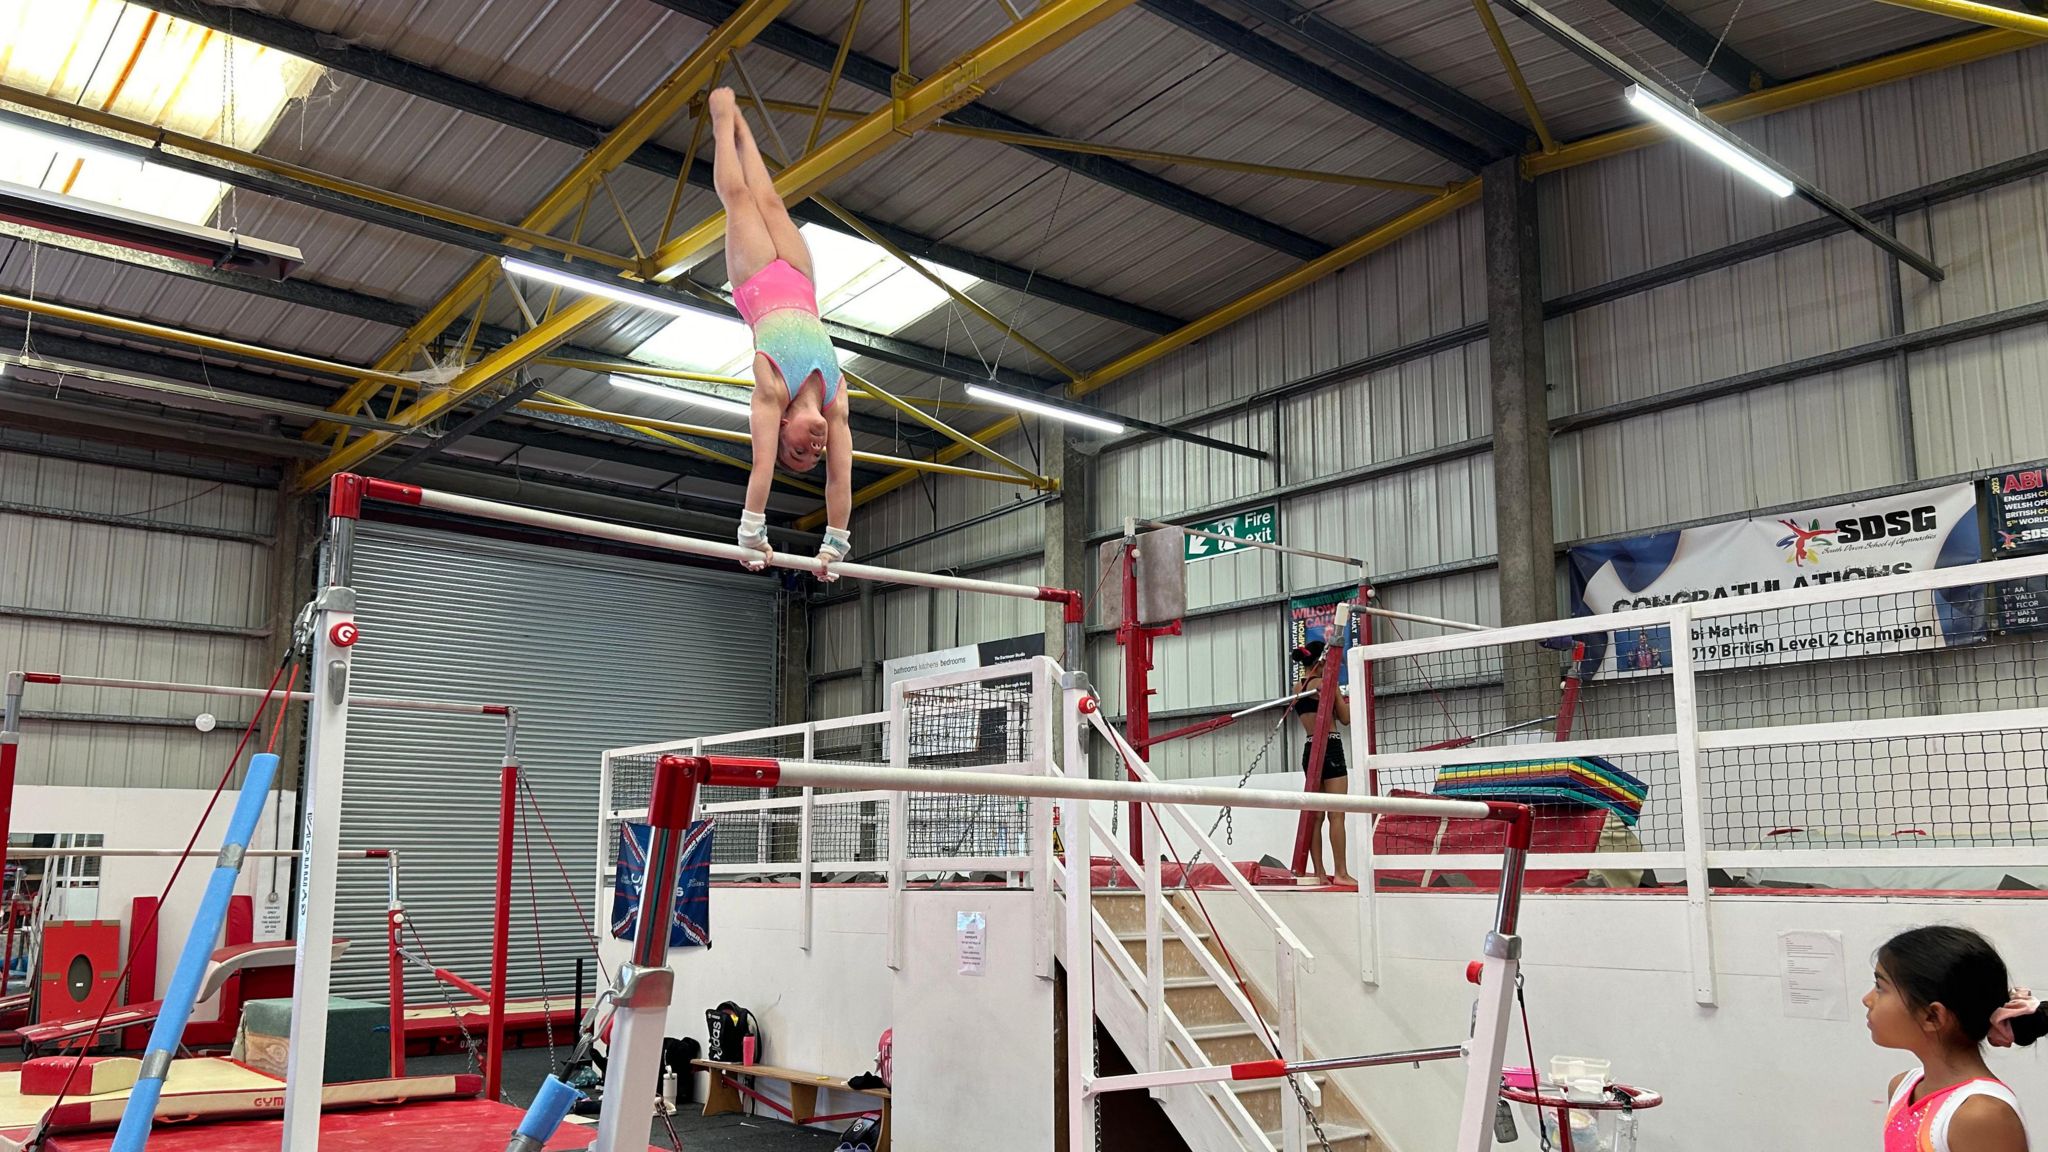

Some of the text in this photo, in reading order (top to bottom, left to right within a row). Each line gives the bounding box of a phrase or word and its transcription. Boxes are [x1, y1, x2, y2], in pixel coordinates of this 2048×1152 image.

[1992, 477, 2000, 494] 2023
[2003, 470, 2044, 493] ABI
[2003, 492, 2037, 502] ENGLISH
[2004, 501, 2033, 510] WELSH
[1245, 512, 1271, 528] Fire
[2005, 508, 2037, 519] BRITISH
[1836, 505, 1936, 544] SDSG
[1246, 527, 1271, 543] exit
[1864, 540, 1888, 550] School
[1888, 538, 1896, 548] of
[1896, 533, 1937, 547] Gymnastics
[1691, 622, 1758, 641] bi Martin
[1721, 640, 1774, 657] British
[1779, 634, 1825, 651] Level
[1829, 633, 1839, 646] 2
[1843, 625, 1933, 645] Champion
[893, 665, 918, 675] bathrooms
[940, 657, 966, 667] bedrooms
